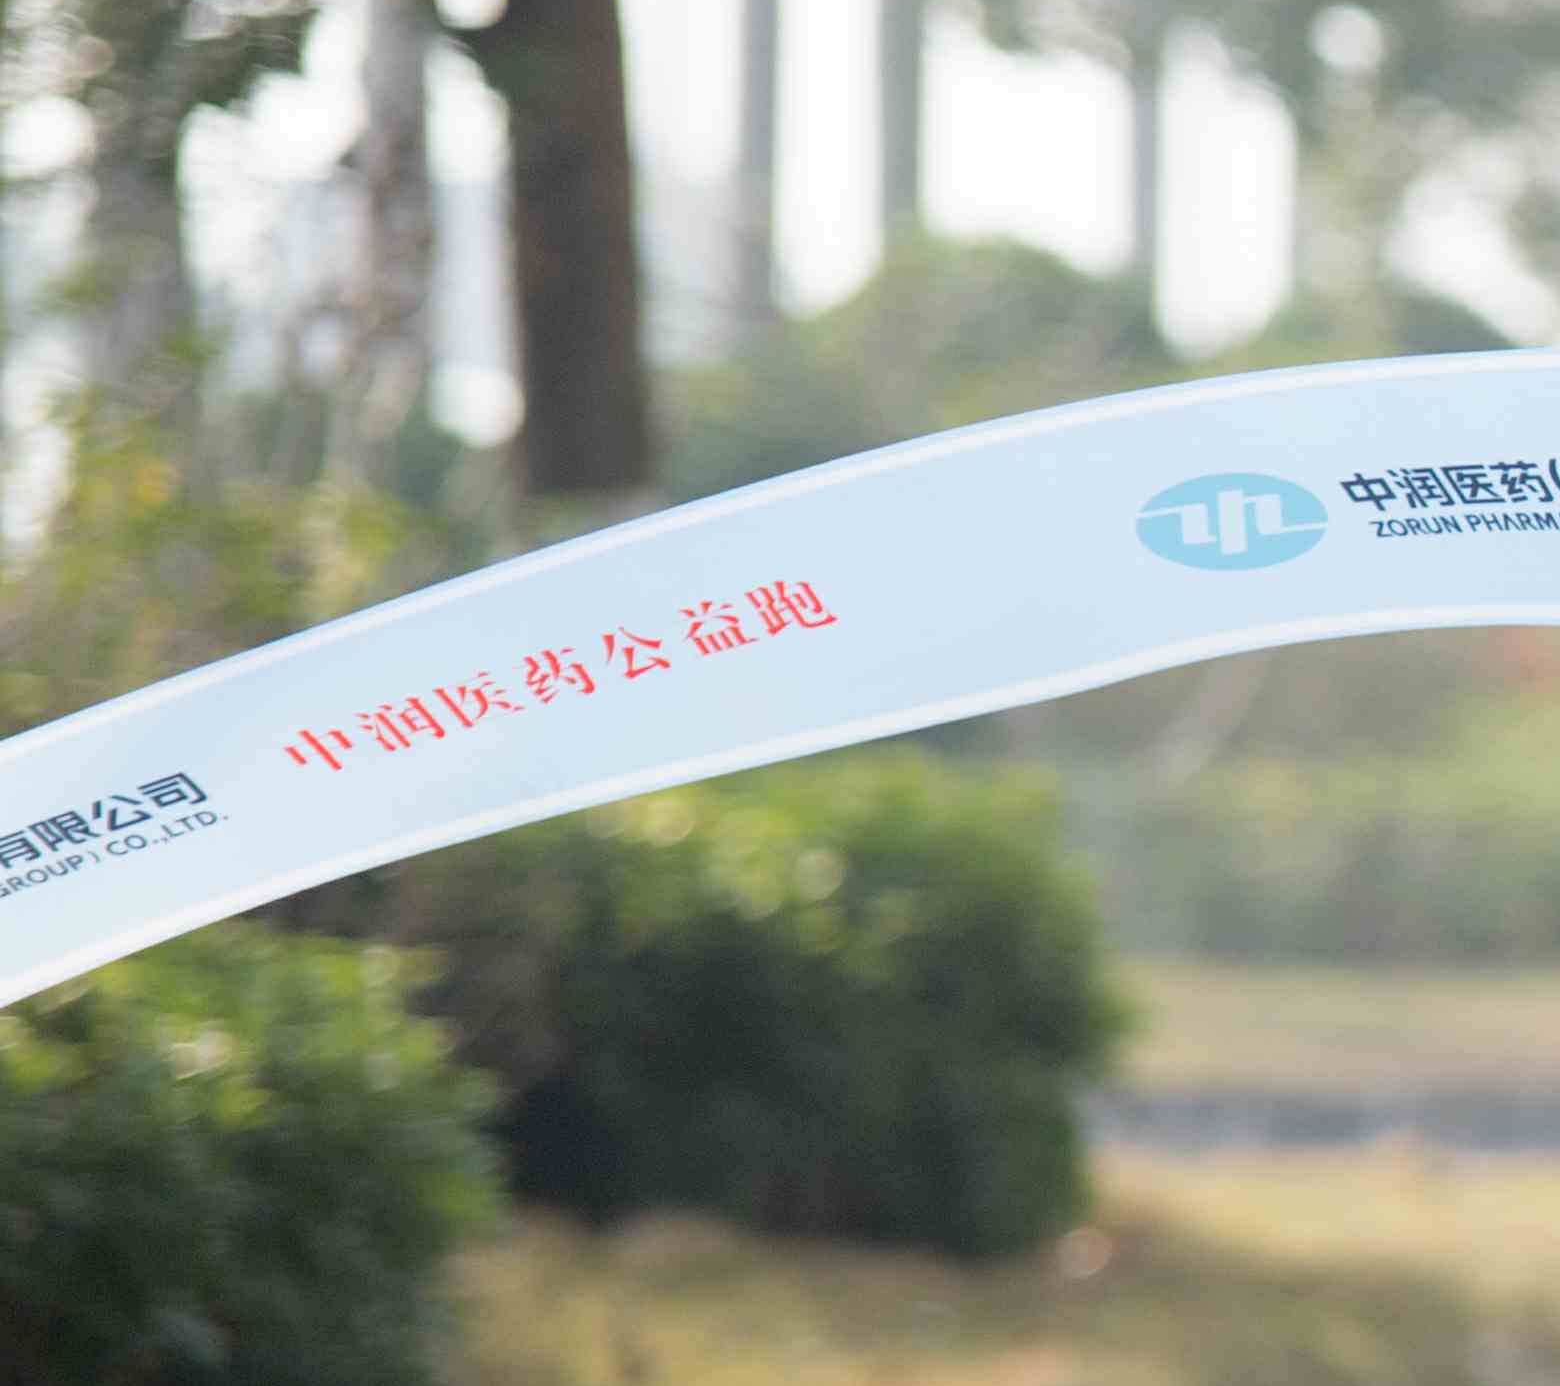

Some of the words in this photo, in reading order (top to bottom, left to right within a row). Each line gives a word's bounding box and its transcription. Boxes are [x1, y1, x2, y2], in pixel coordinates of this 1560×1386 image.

[1369, 514, 1461, 538] ZORUN
[281, 579, 839, 773] 中润医药公益跑
[105, 810, 229, 856] CO.,LTD.
